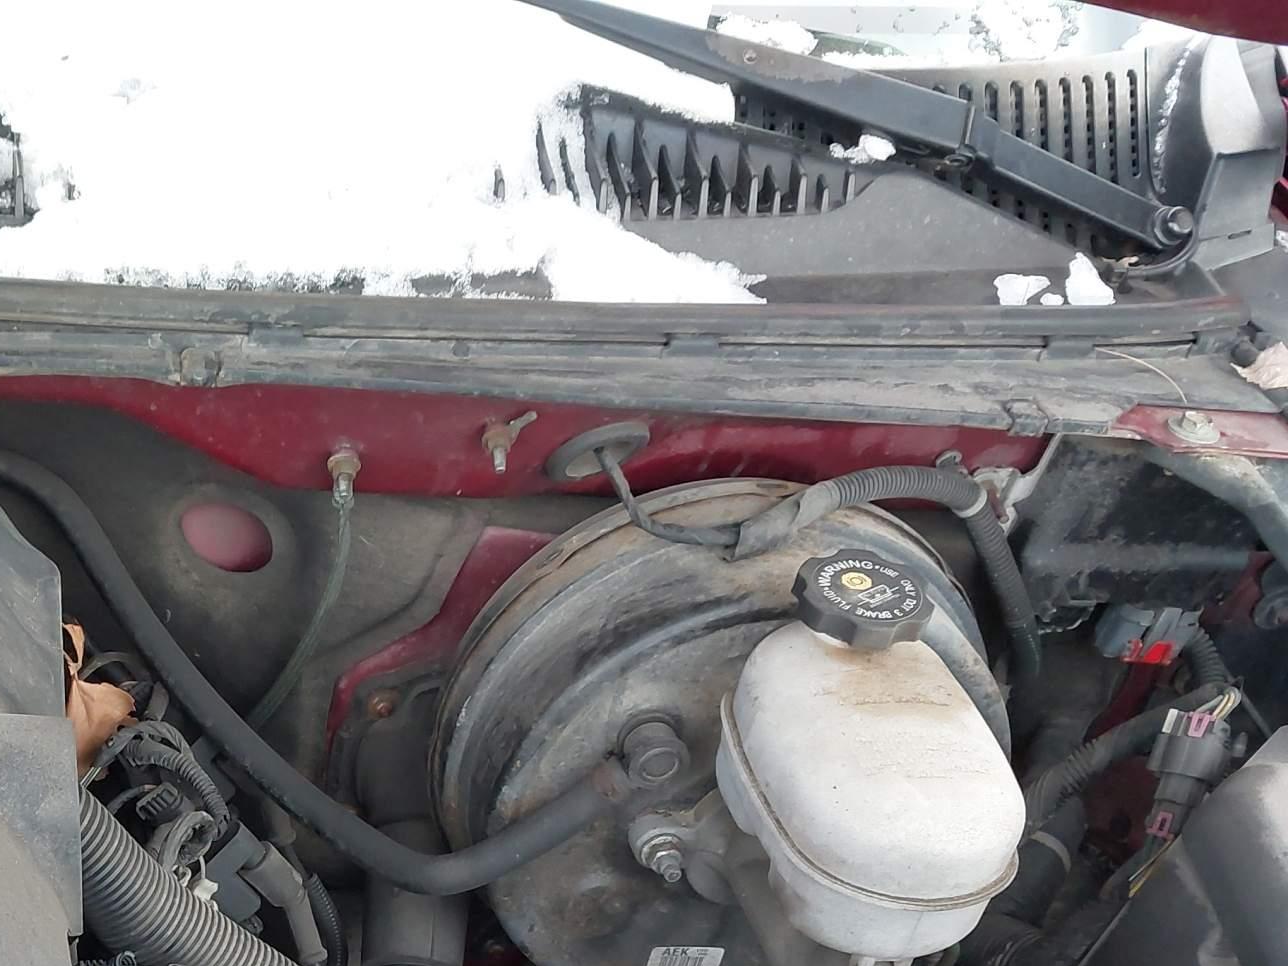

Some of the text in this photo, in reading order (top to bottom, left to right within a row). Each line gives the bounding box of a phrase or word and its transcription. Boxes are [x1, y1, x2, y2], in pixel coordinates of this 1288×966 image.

[817, 559, 873, 587] WARNING
[822, 589, 852, 611] FLUID
[855, 606, 893, 619] BRAKE
[893, 608, 904, 617] 3
[662, 947, 690, 957] AEK
